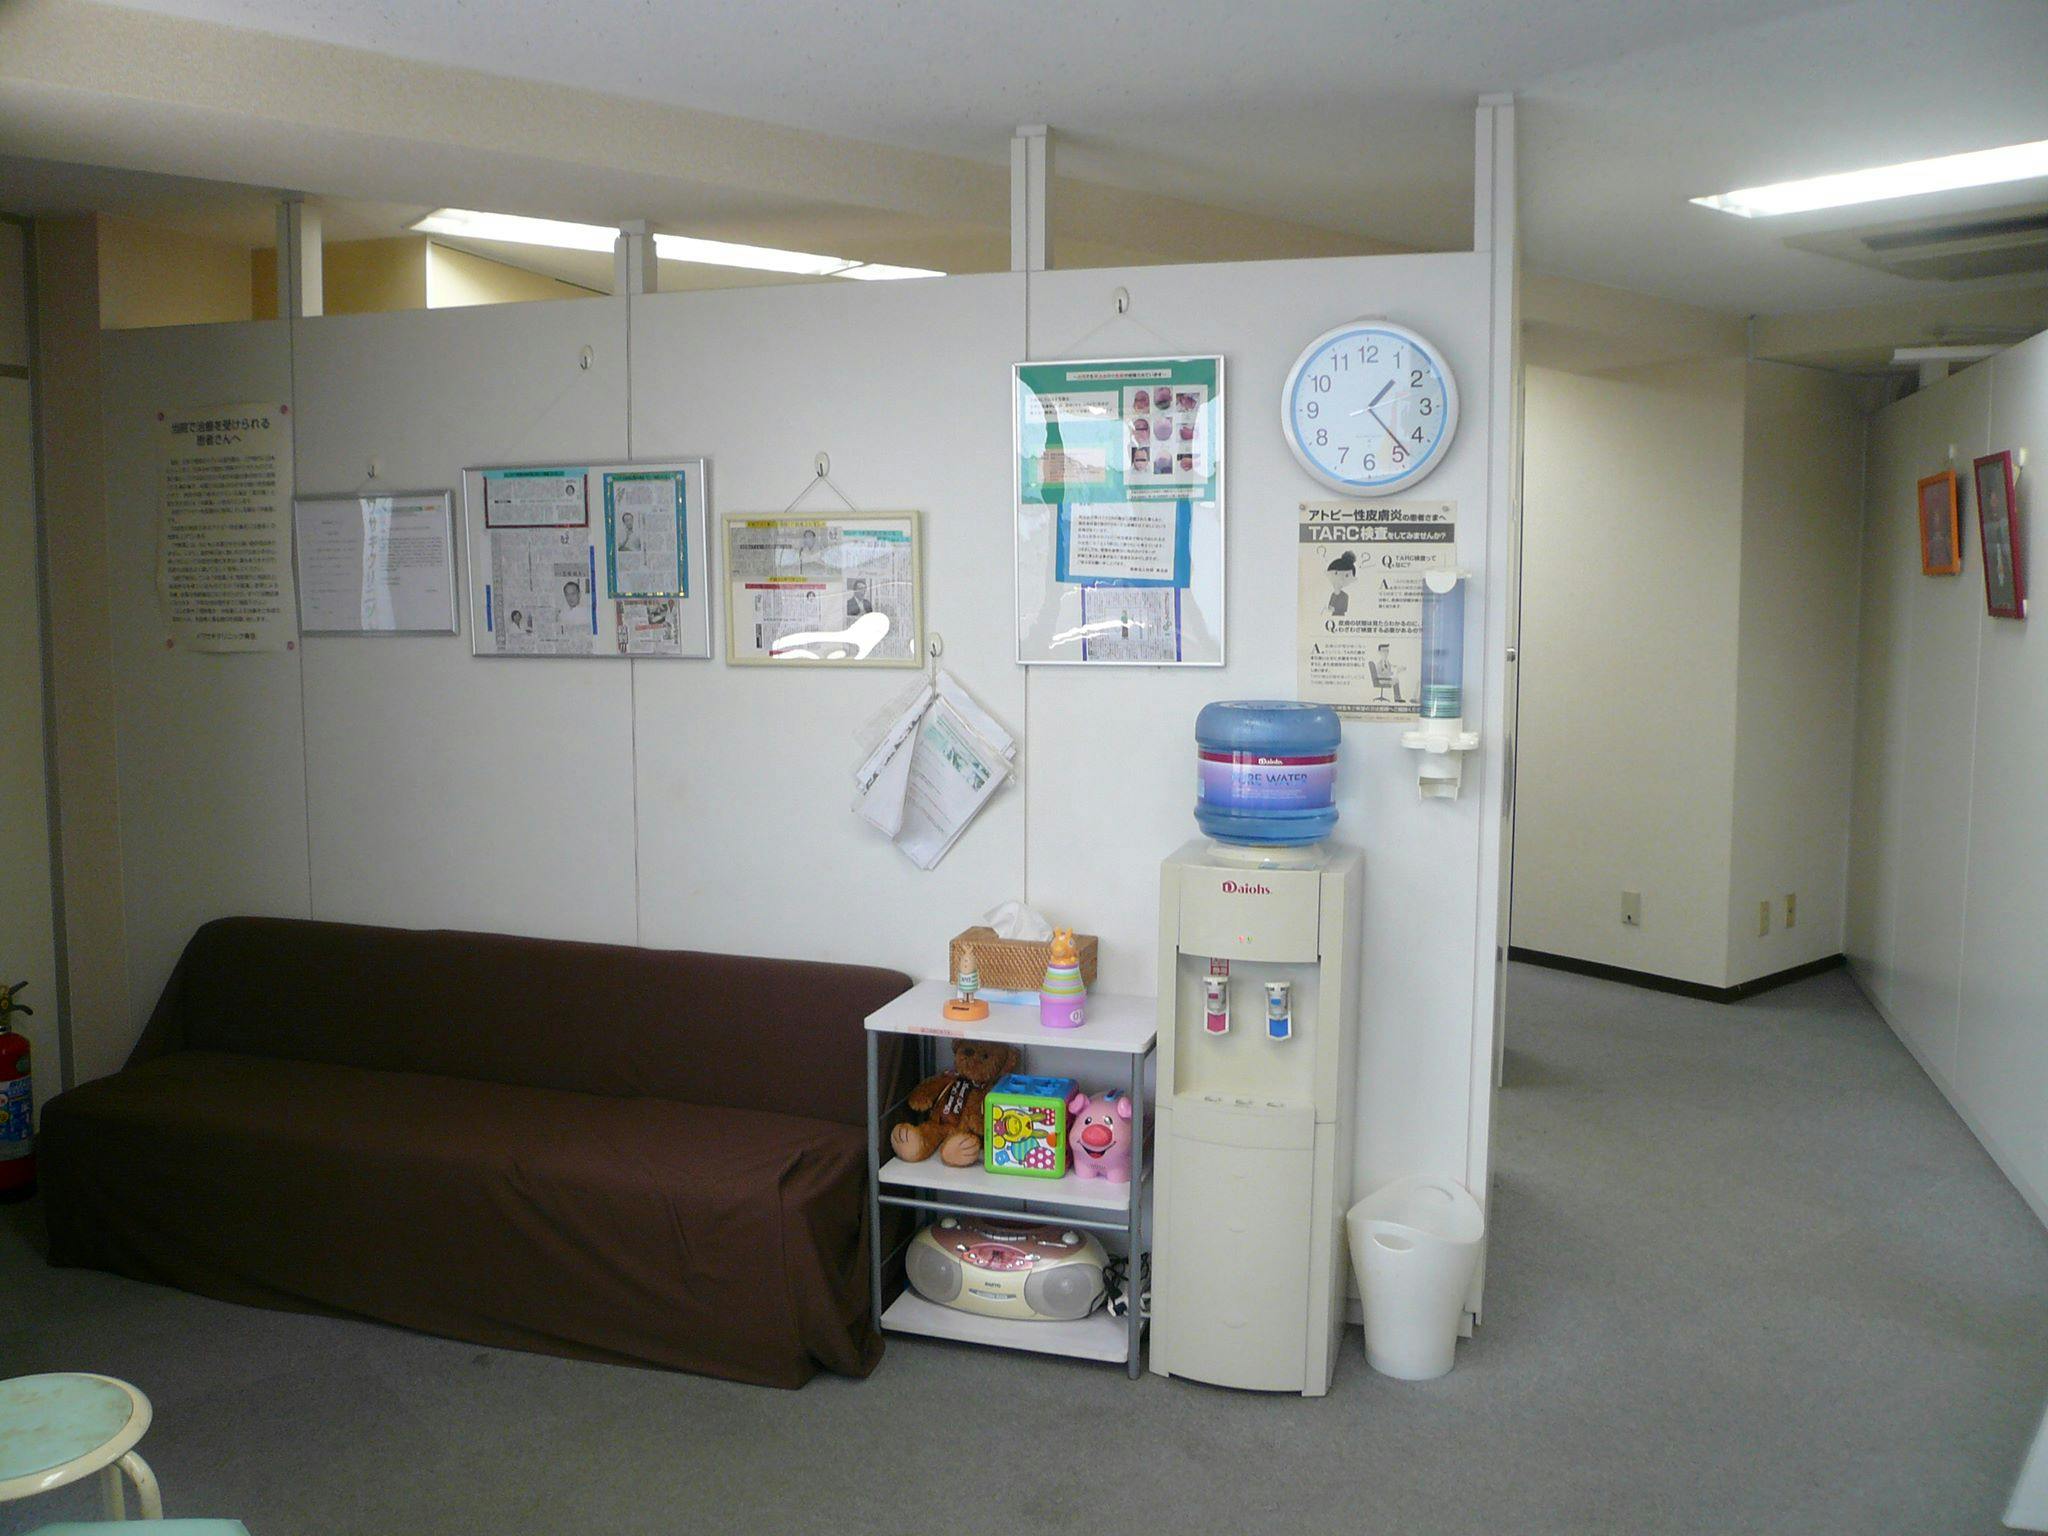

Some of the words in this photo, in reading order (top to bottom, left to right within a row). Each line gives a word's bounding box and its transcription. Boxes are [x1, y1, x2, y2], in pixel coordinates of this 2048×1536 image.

[1331, 354, 1349, 371] 11
[1358, 345, 1379, 364] 12
[1393, 352, 1401, 369] 1
[1311, 375, 1331, 393] 10
[1410, 370, 1423, 388] 2
[1307, 401, 1319, 419] 9
[1419, 398, 1432, 416] 3
[1316, 429, 1328, 446] 8
[1411, 426, 1424, 443] 4
[1338, 447, 1350, 464] 7
[1363, 453, 1376, 471] 6
[1392, 445, 1404, 463] 5
[1308, 509, 1447, 522] アトピー性皮膚炎の患者さまへ
[1266, 773, 1308, 787] WATER
[1221, 880, 1272, 895] Daiohs
